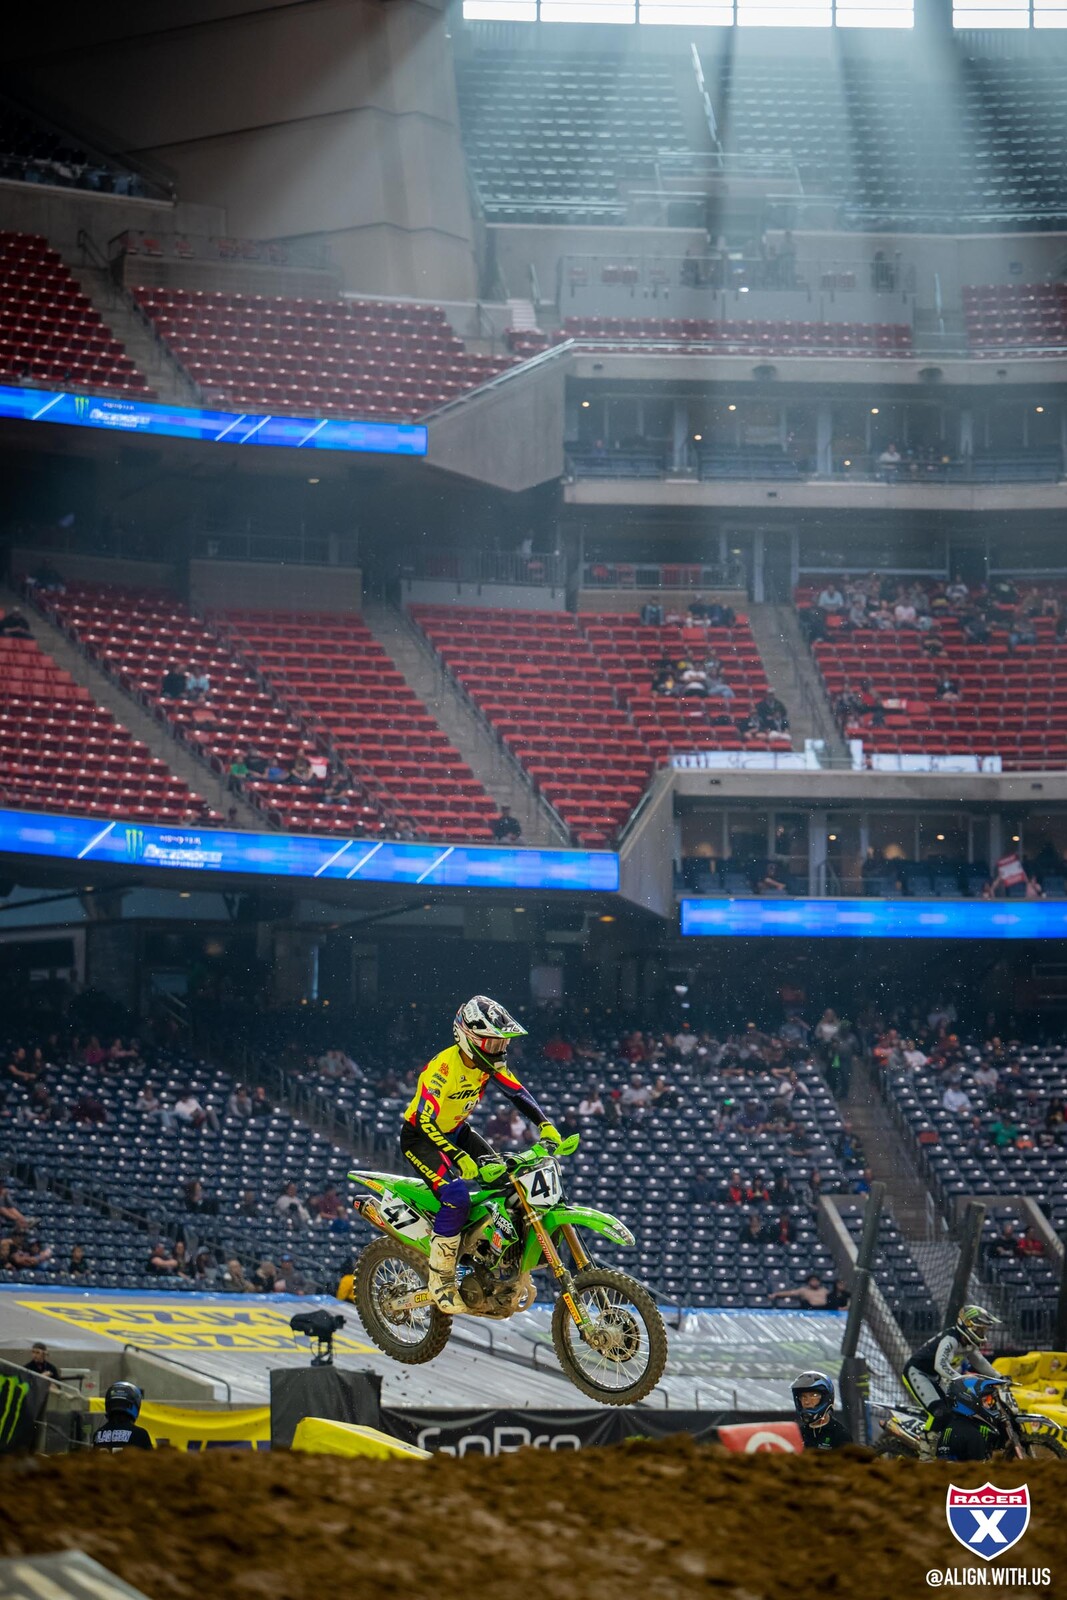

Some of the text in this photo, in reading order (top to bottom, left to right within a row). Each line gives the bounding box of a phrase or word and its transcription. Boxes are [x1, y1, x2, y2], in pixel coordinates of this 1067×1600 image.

[419, 1099, 458, 1152] CIRCUIT
[404, 1150, 450, 1187] CIRCUIT
[383, 1203, 420, 1230] 47
[417, 1427, 581, 1459] GoPro
